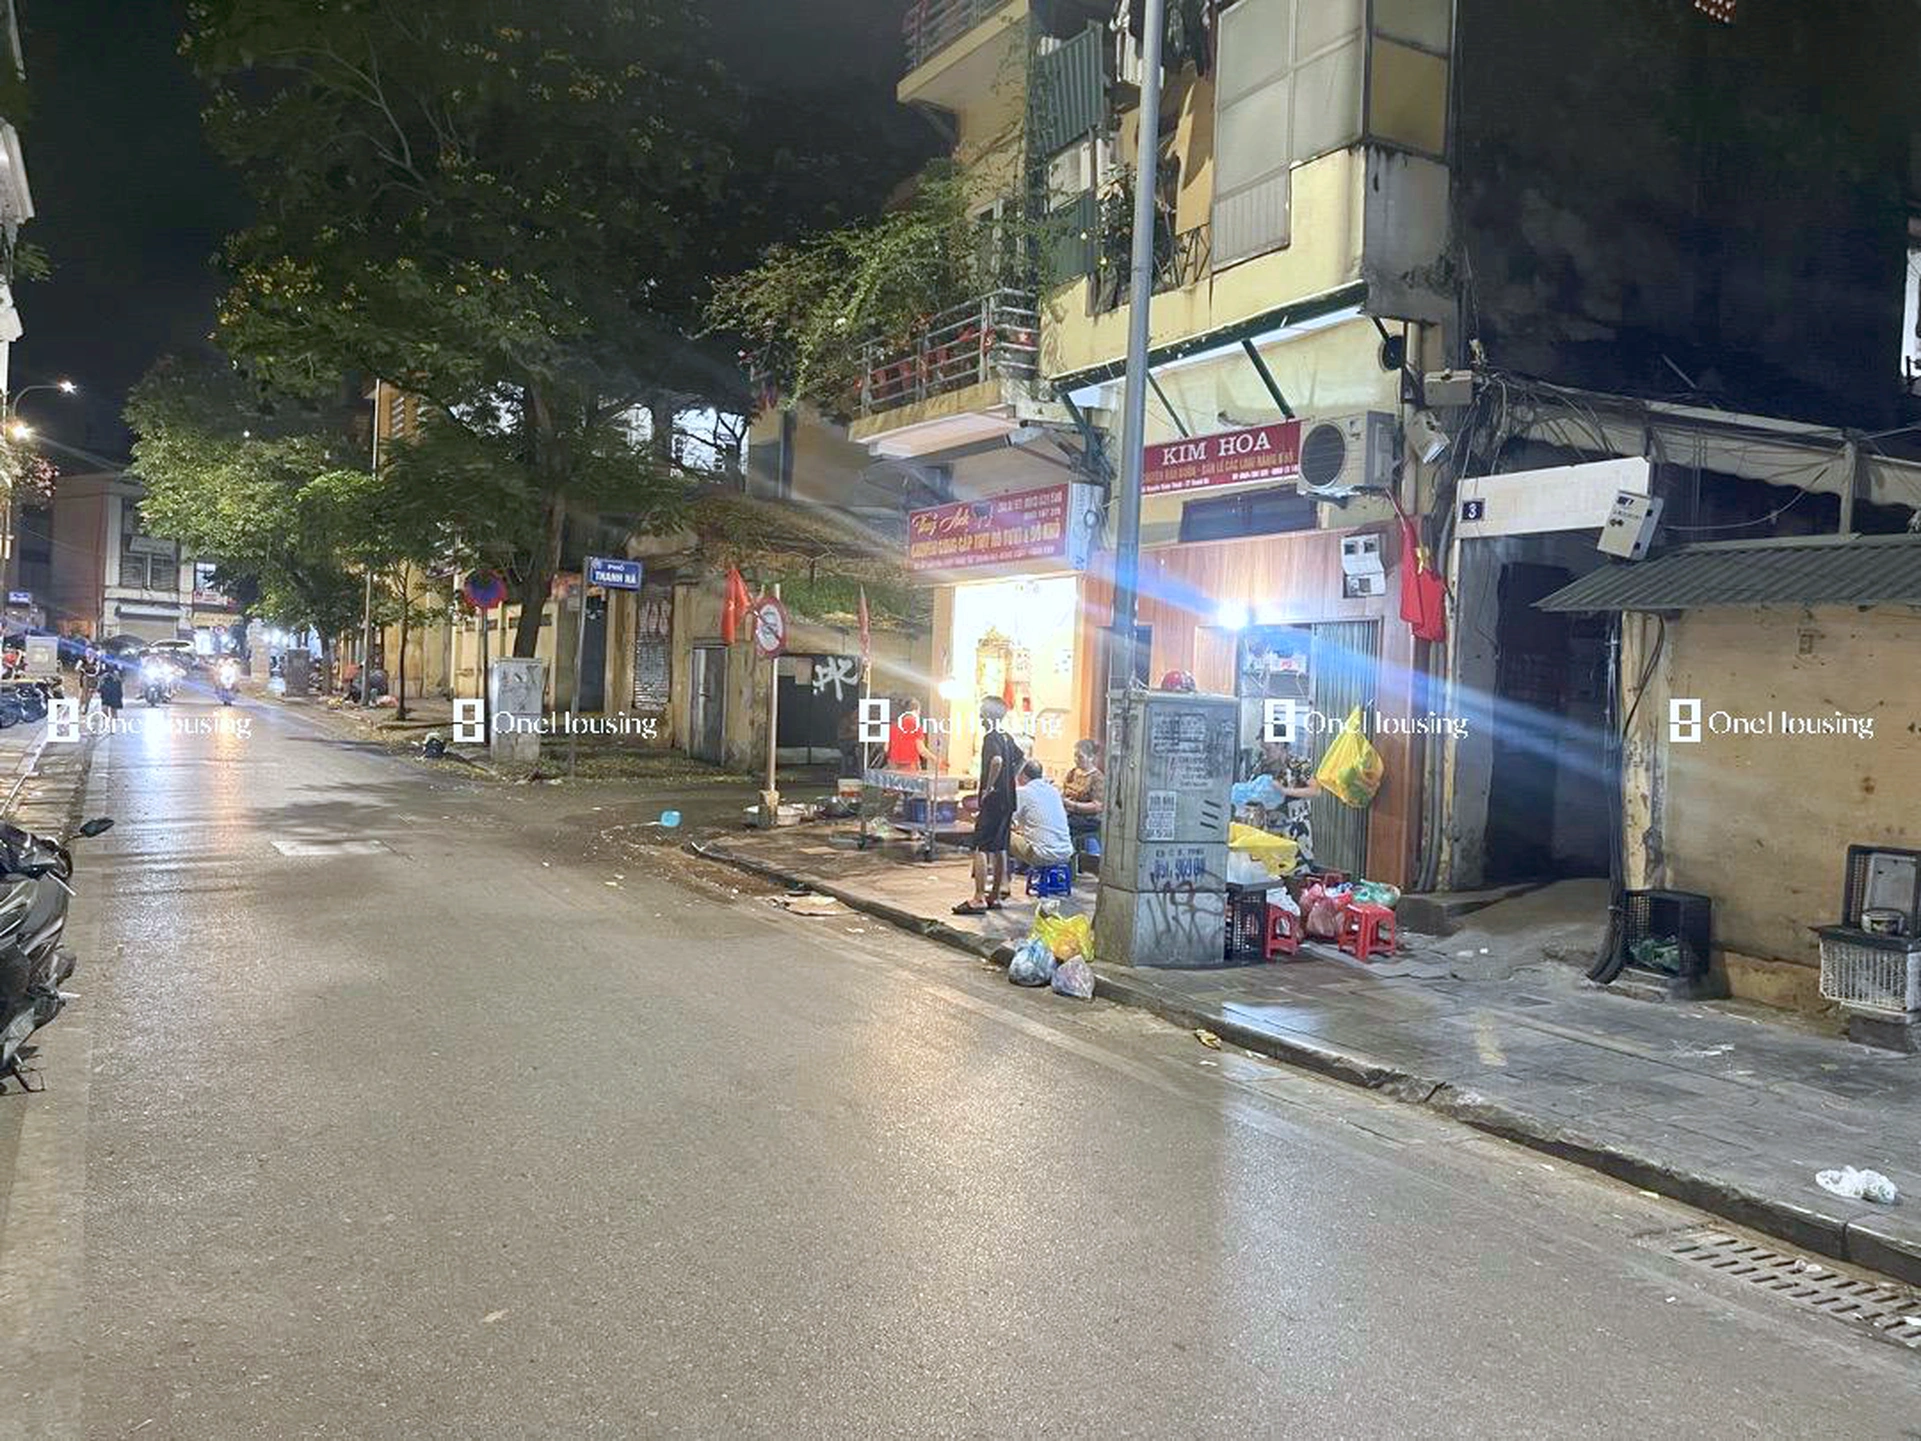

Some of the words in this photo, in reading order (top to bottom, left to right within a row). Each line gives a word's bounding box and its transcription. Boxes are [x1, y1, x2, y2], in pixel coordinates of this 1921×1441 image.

[1162, 441, 1208, 466] KIM
[1218, 431, 1271, 457] HOA
[608, 562, 625, 571] PHỐ
